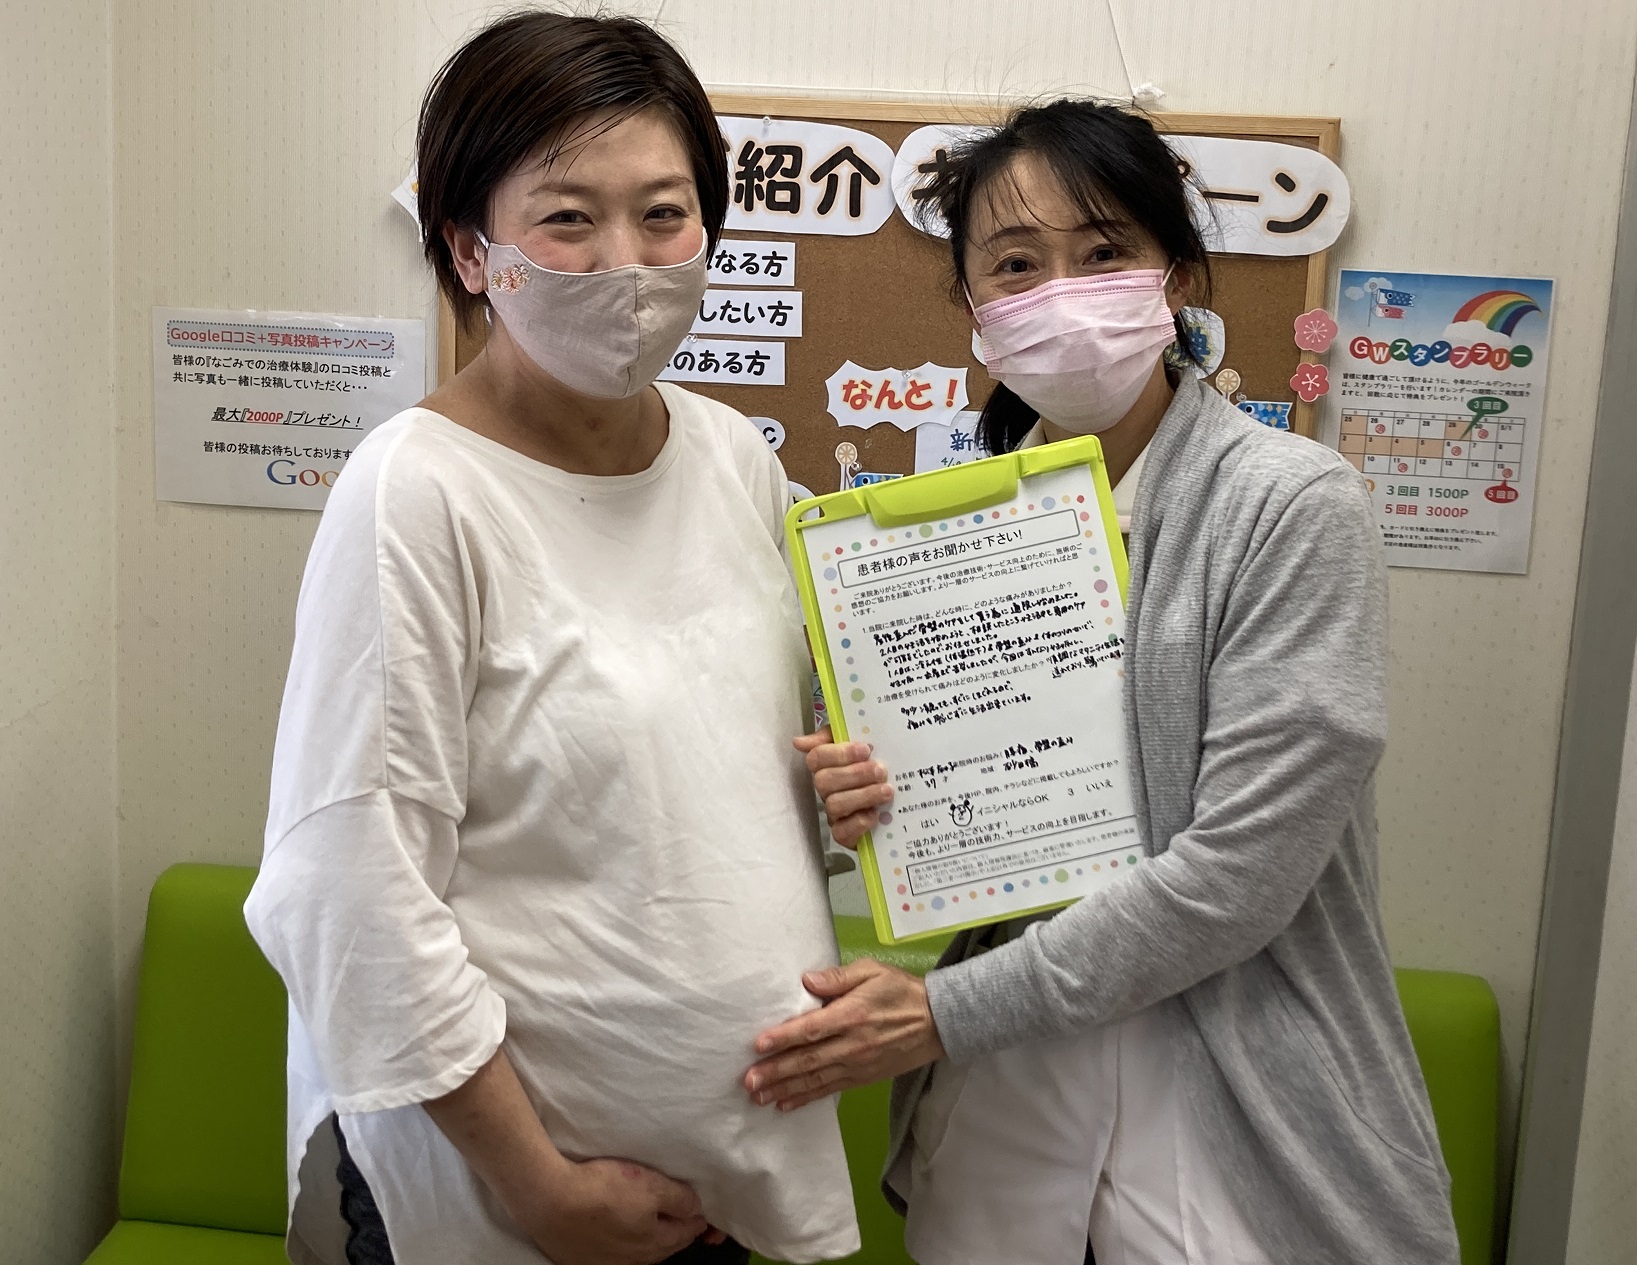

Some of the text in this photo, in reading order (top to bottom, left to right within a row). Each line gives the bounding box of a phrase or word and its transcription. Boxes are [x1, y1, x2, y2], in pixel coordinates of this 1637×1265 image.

[724, 140, 880, 217] 紹介
[707, 250, 788, 277] なる方
[667, 350, 770, 376] のある方
[1352, 338, 1530, 369] GWスタンプラリー
[267, 459, 339, 487] Goo
[1428, 487, 1469, 499] 1500P
[1425, 505, 1469, 518] 3000P
[921, 818, 939, 829] はい
[1086, 780, 1113, 793] いいえ
